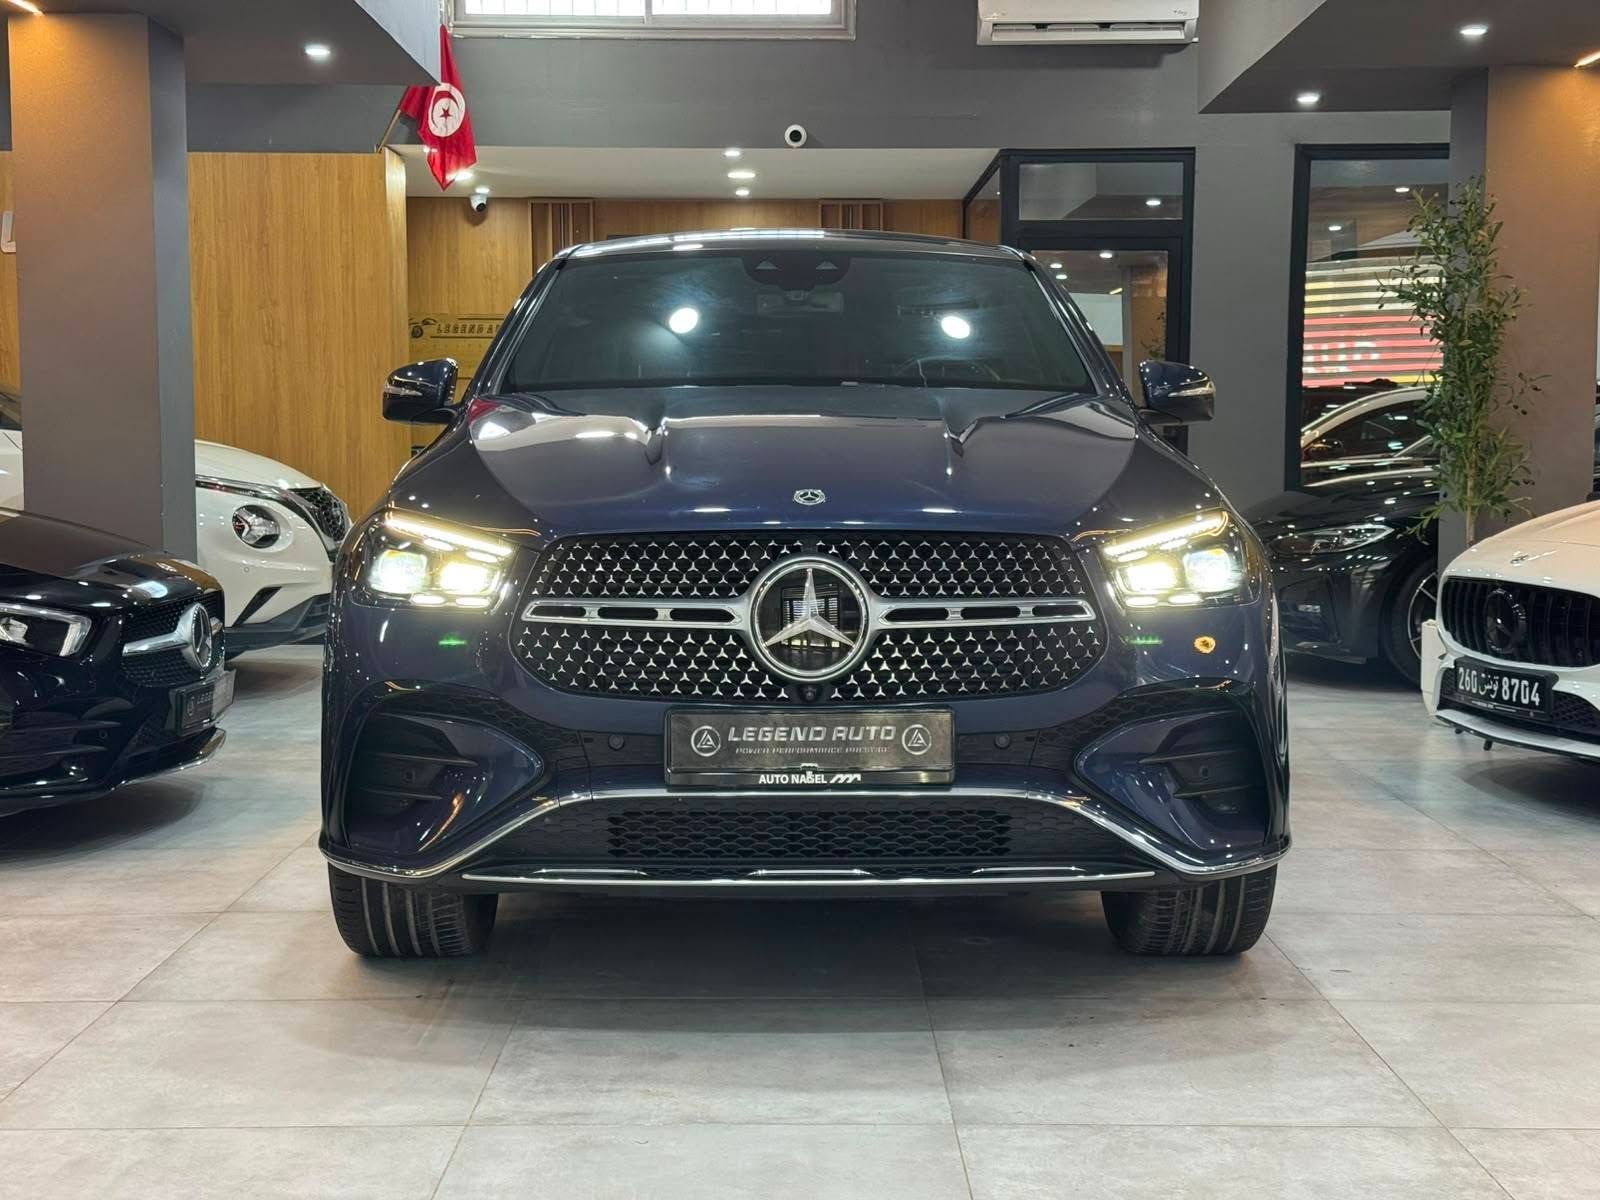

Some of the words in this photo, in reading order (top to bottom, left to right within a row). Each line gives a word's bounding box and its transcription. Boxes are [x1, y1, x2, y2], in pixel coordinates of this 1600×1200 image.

[1458, 666, 1478, 694] 260
[1478, 672, 1500, 699] تونس
[1501, 676, 1540, 707] 8704
[728, 726, 827, 742] LEGEND
[831, 726, 896, 742] AUTO
[758, 773, 790, 785] AUTO
